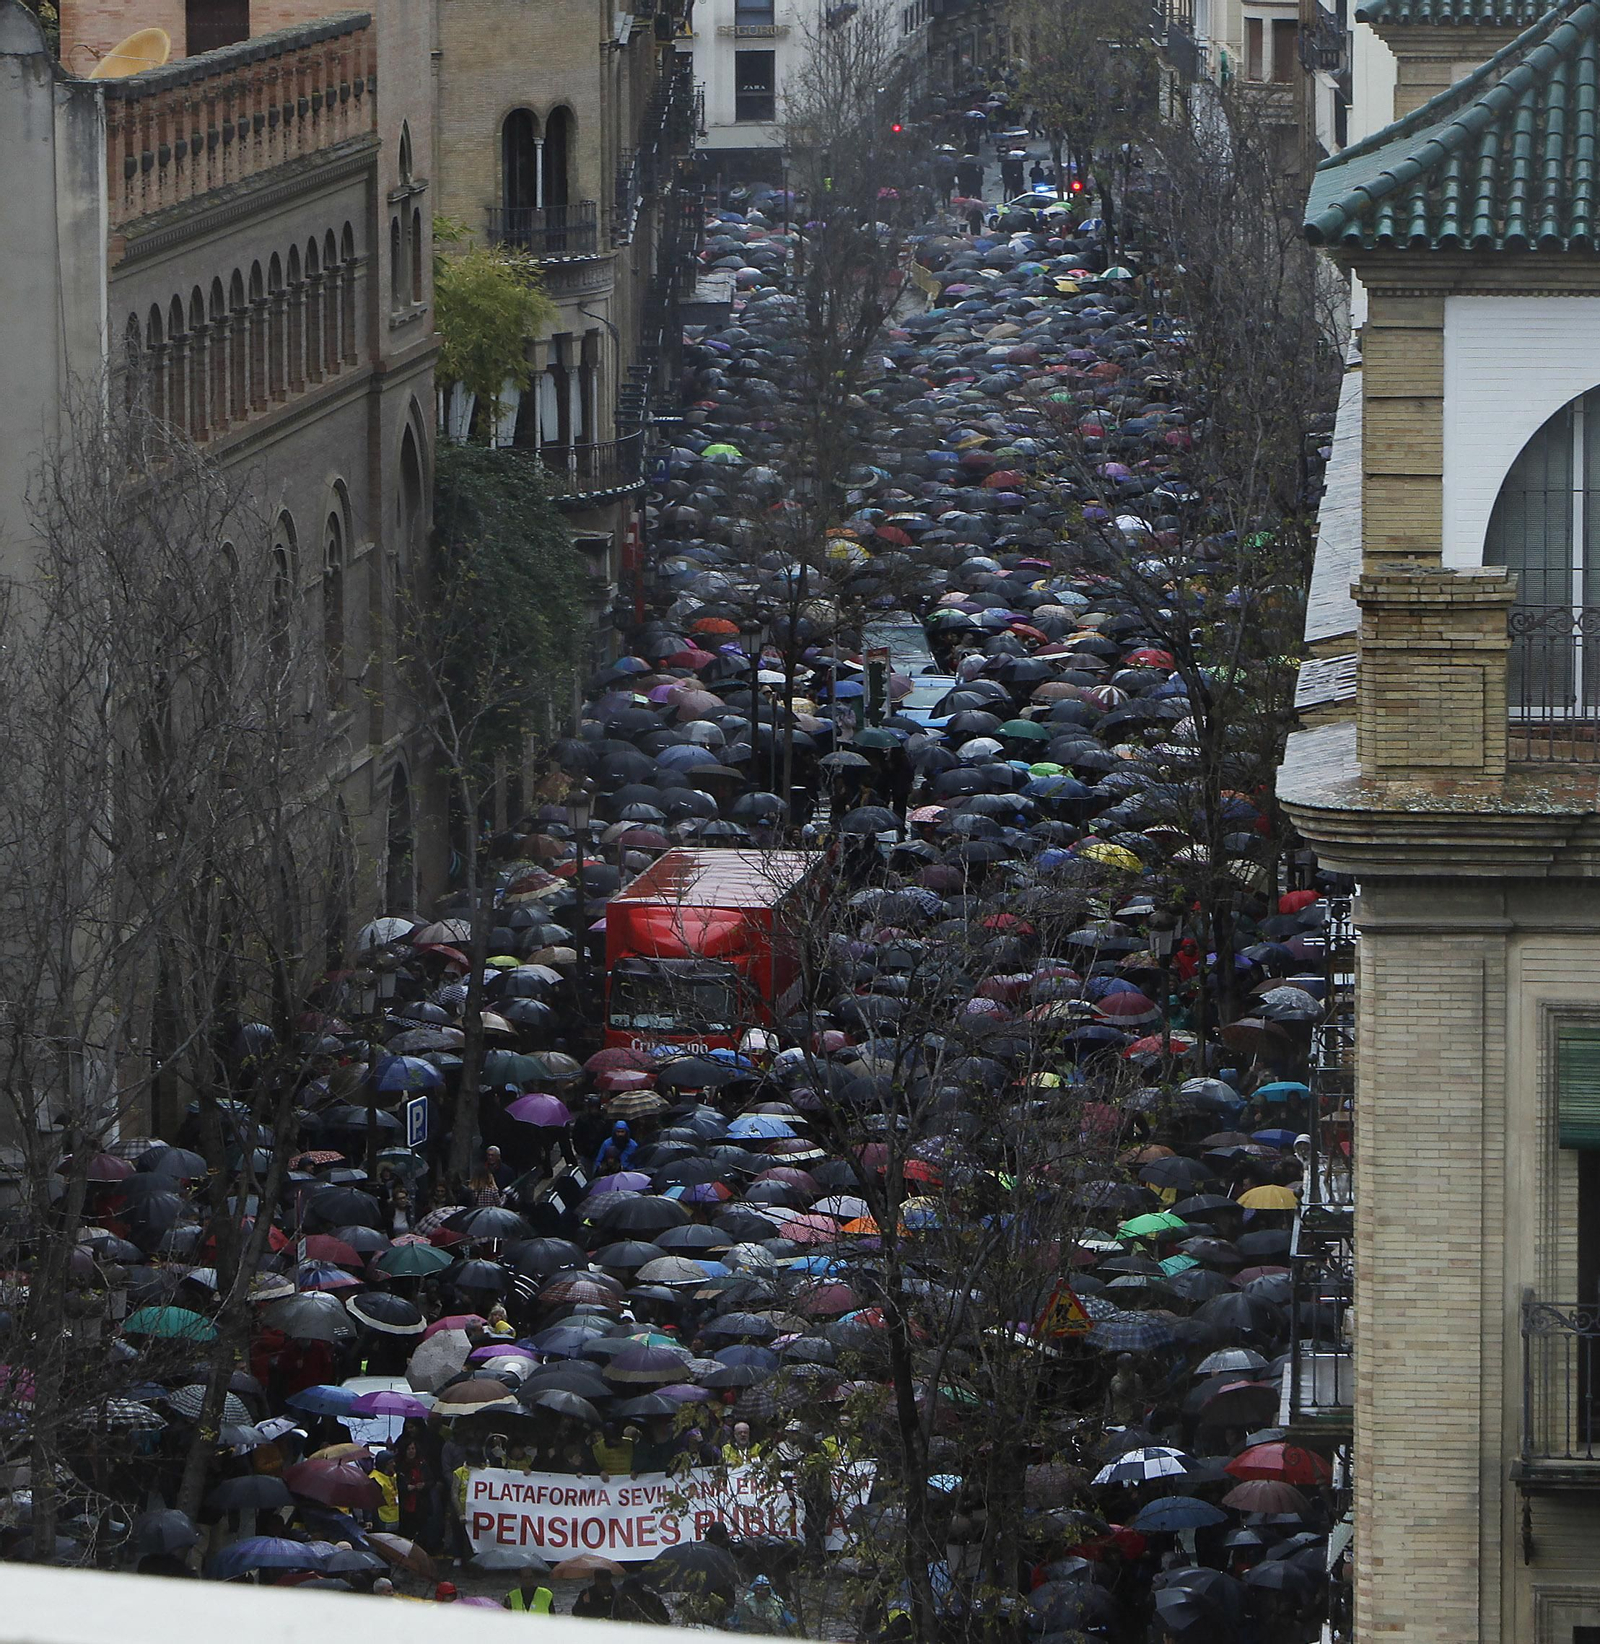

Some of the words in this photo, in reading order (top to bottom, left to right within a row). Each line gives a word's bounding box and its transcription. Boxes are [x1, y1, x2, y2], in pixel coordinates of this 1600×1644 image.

[716, 24, 791, 37] SEGUROS
[412, 1105, 424, 1141] P
[474, 1481, 611, 1507] PLATAFORMA
[473, 1512, 681, 1549] PENSIONES
